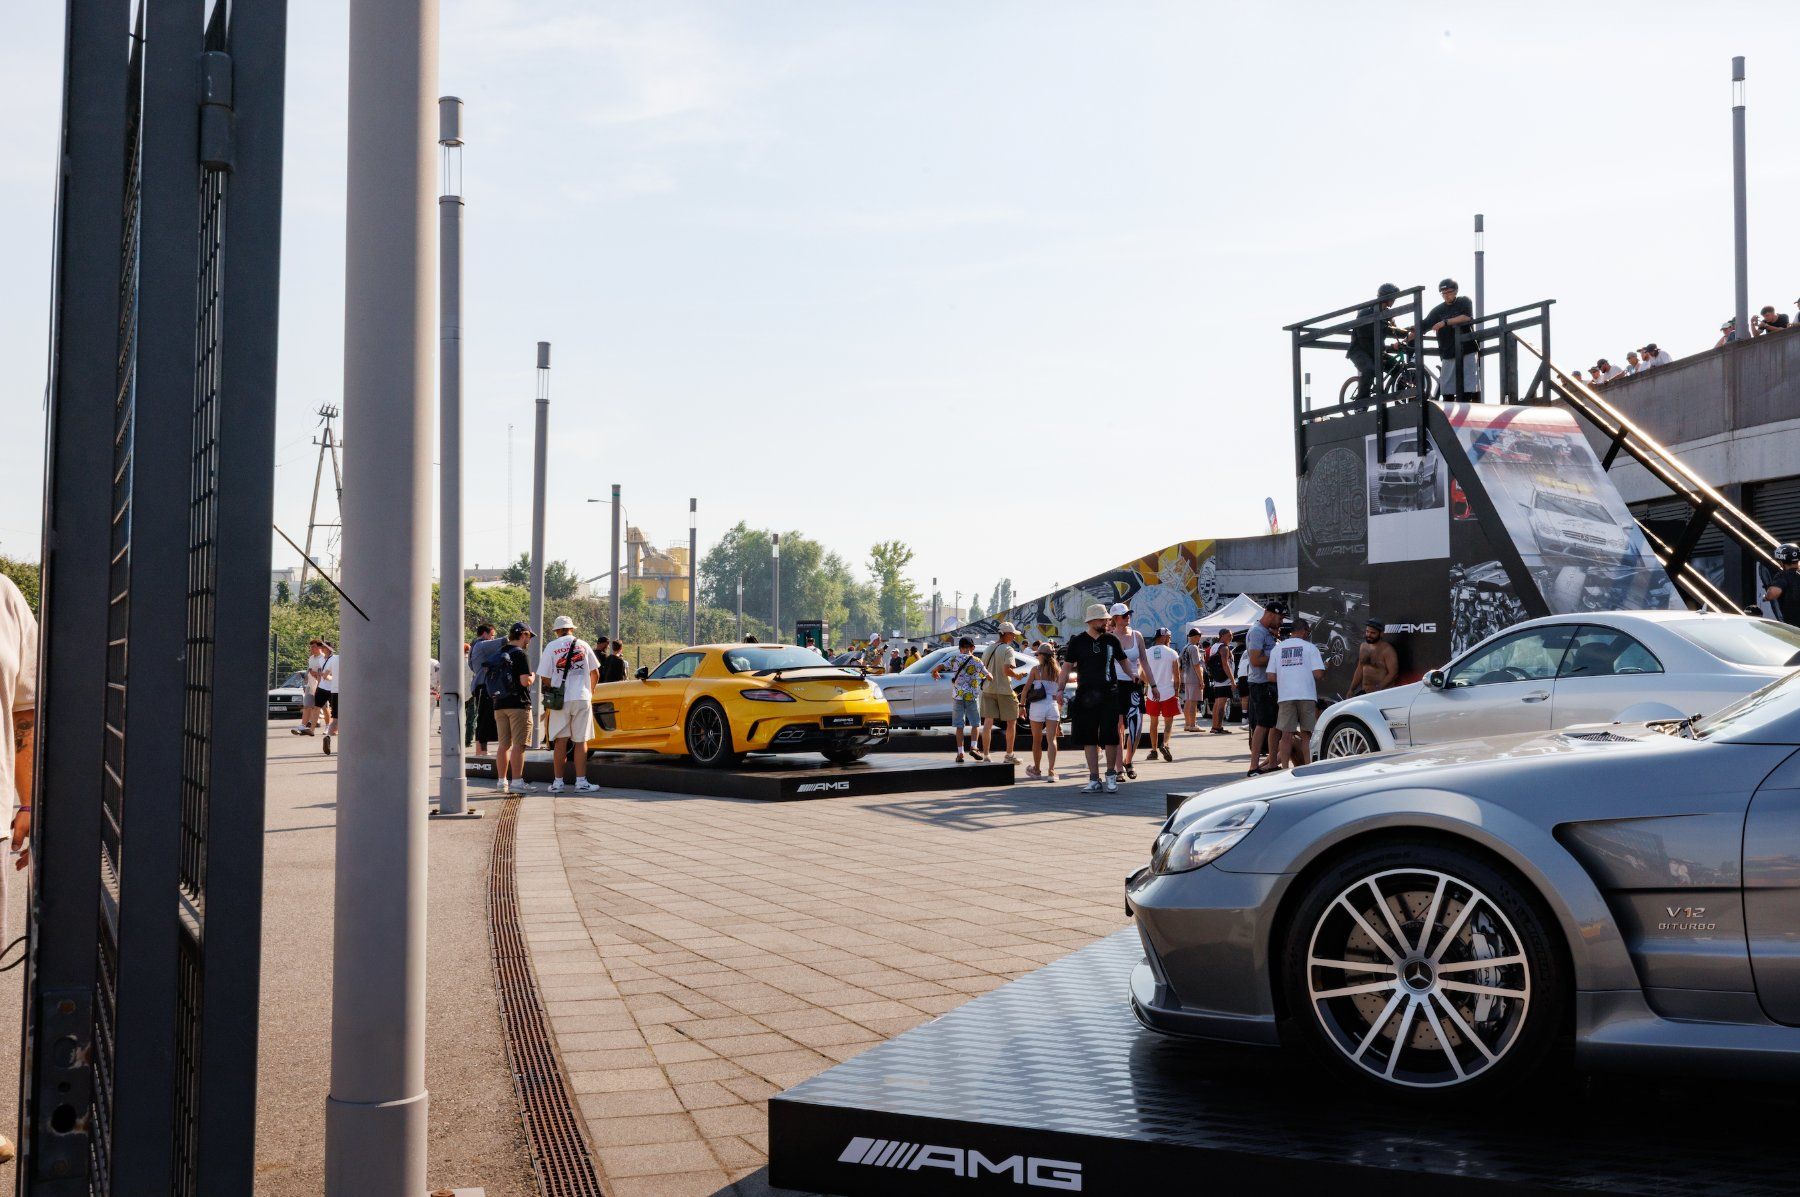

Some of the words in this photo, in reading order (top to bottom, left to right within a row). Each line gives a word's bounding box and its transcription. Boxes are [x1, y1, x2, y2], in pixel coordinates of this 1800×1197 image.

[1331, 544, 1366, 555] AMG
[1399, 622, 1437, 634] AMG
[471, 763, 492, 771] AMG
[815, 781, 850, 791] AMG
[1666, 907, 1706, 918] V12
[1658, 922, 1716, 931] BITURBO
[908, 1144, 1082, 1192] AMG
